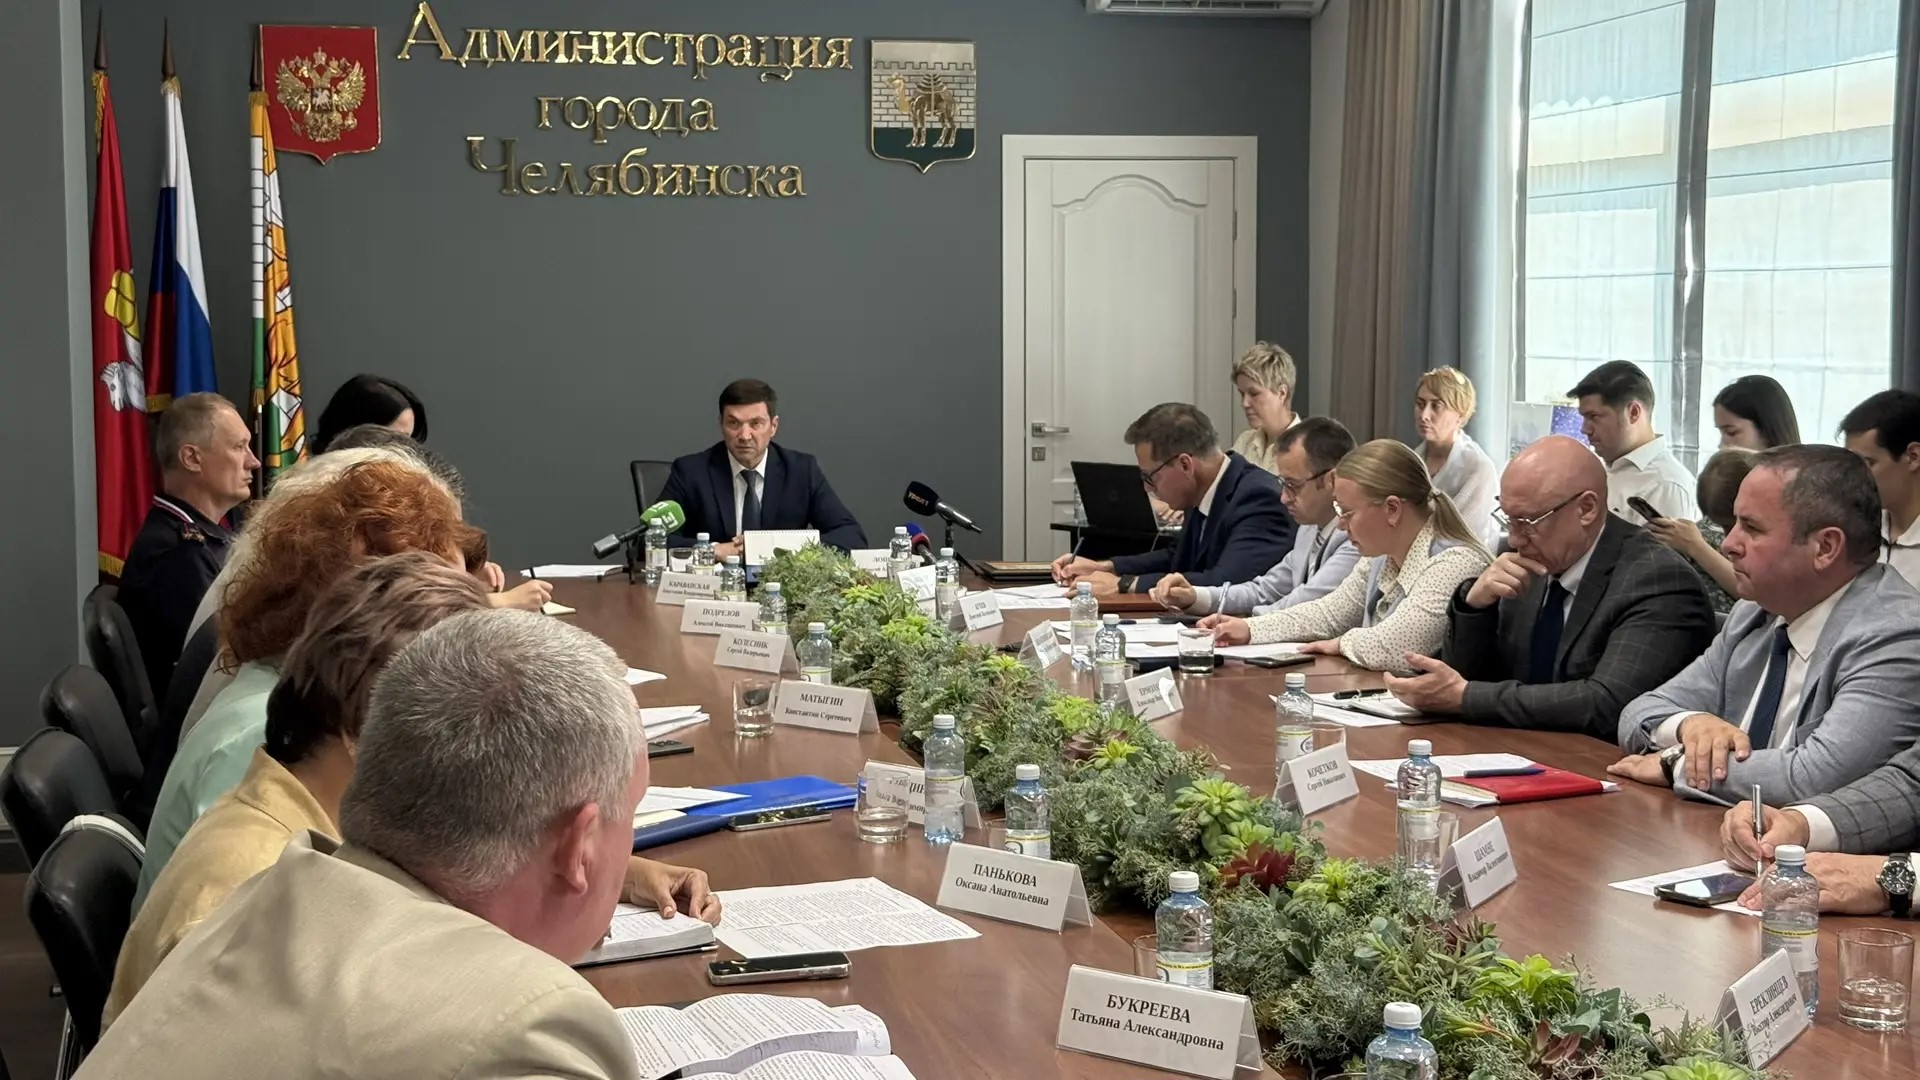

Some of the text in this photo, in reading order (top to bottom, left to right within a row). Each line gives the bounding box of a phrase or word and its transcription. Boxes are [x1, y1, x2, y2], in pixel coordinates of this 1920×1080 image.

[397, 1, 854, 82] Администрация
[537, 95, 718, 144] города
[465, 135, 807, 198] Челябинска
[702, 608, 741, 618] ПОДРЕЗОВ
[733, 637, 769, 649] КОЛЕСНИК
[800, 693, 844, 706] МАТЫГИН
[785, 707, 852, 722] Константин Сергеевич
[1307, 760, 1338, 778] КОЧЕТКОВ
[973, 863, 1037, 887] ПАНЬКОВА
[955, 876, 1049, 906] Оксана Анатольевна
[1106, 994, 1191, 1024] БУКРЕЕВА
[1071, 1007, 1225, 1051] Татьяна Александровна
